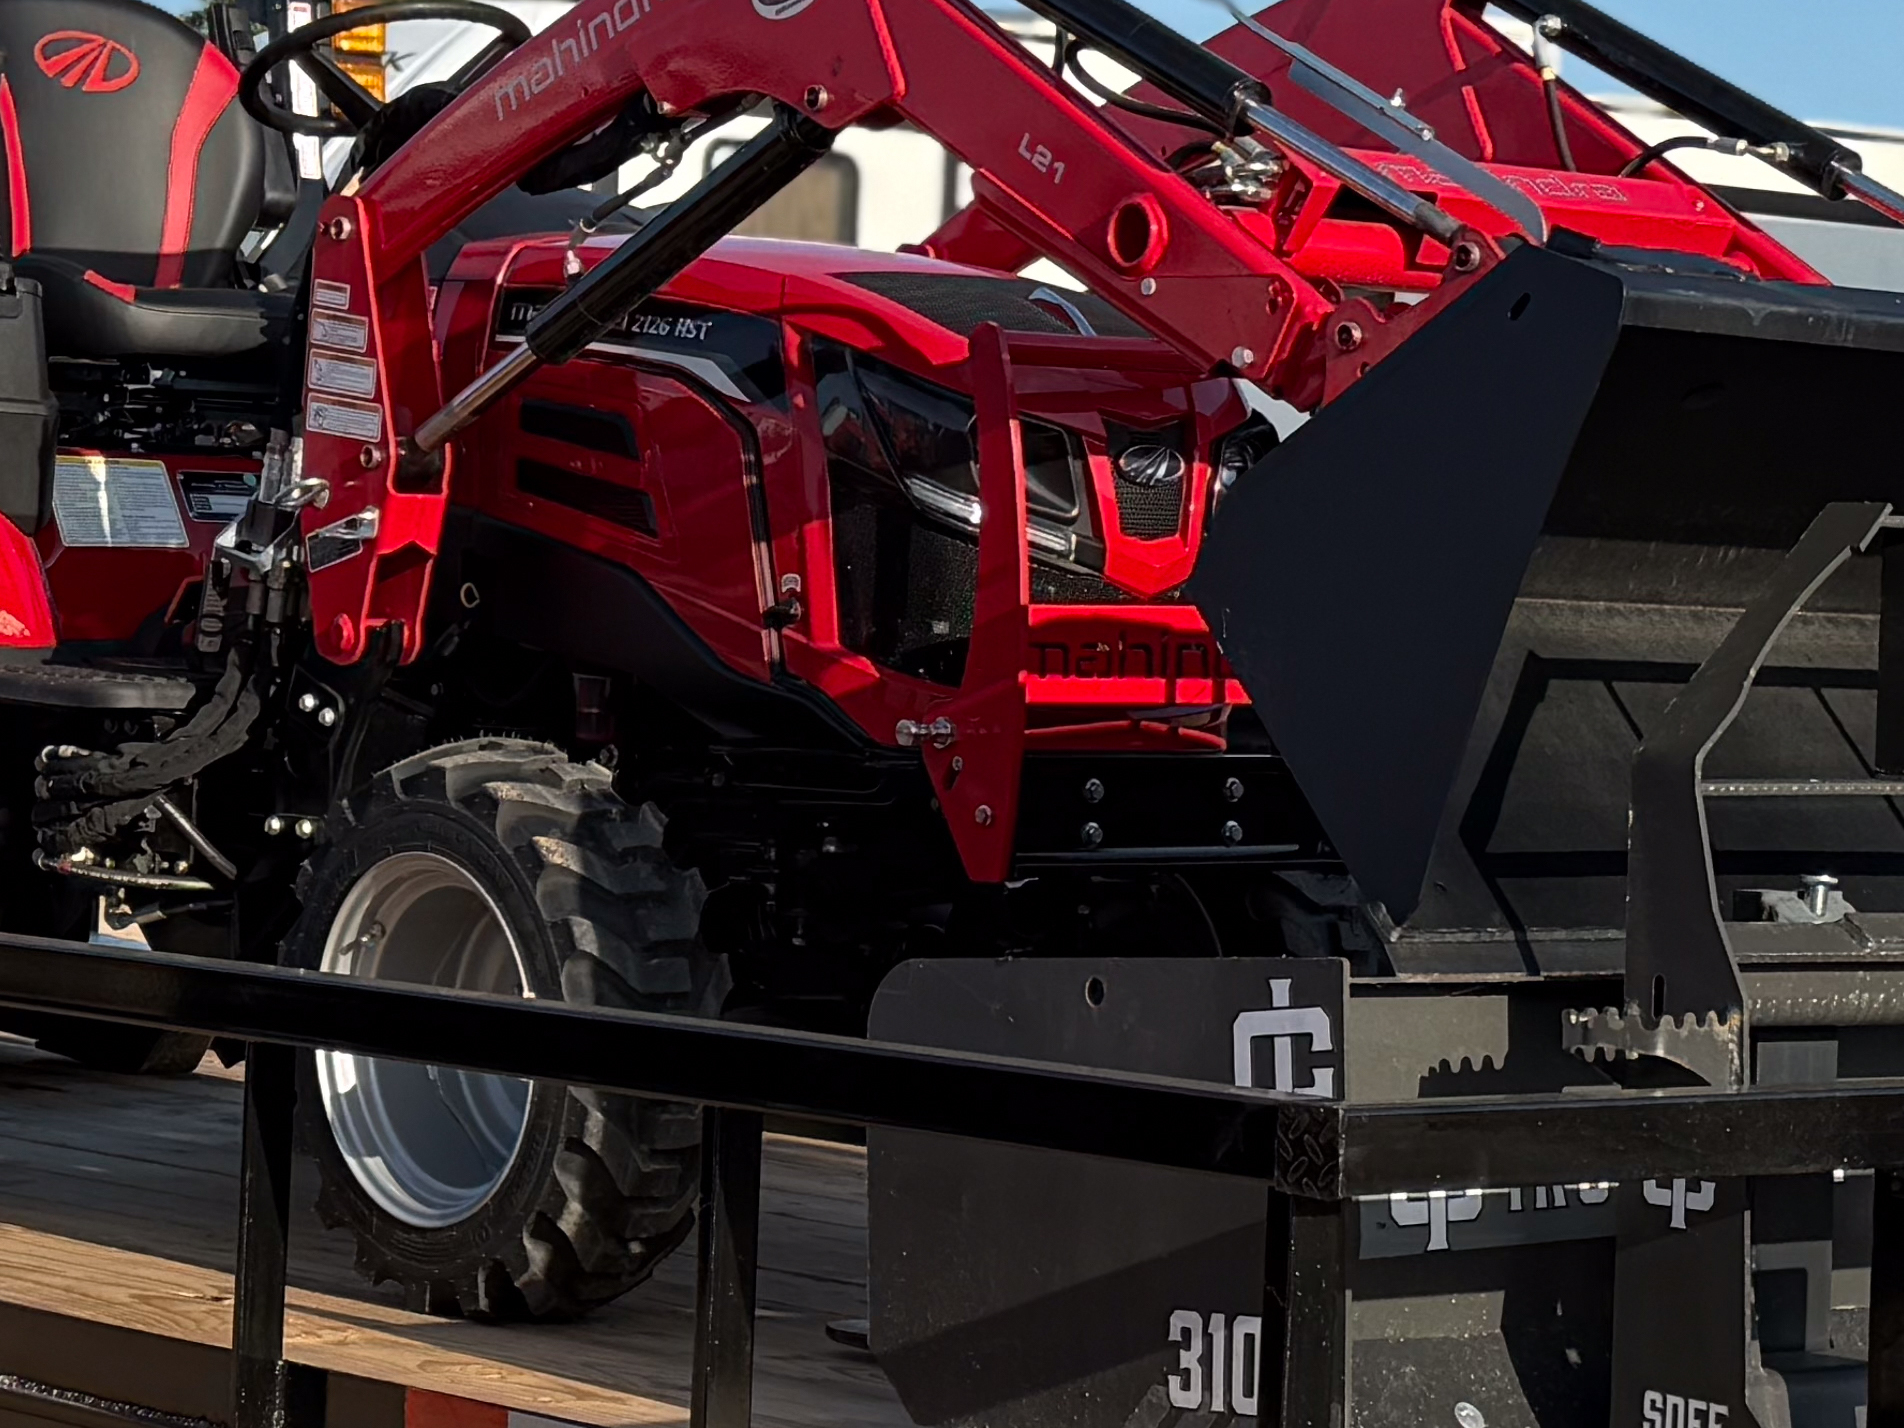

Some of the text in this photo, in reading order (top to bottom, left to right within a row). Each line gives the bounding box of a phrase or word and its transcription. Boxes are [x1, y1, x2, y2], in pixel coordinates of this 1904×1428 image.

[1018, 132, 1065, 184] L21
[631, 314, 672, 336] 2126
[674, 317, 713, 340] HST
[1167, 1309, 1262, 1416] 310
